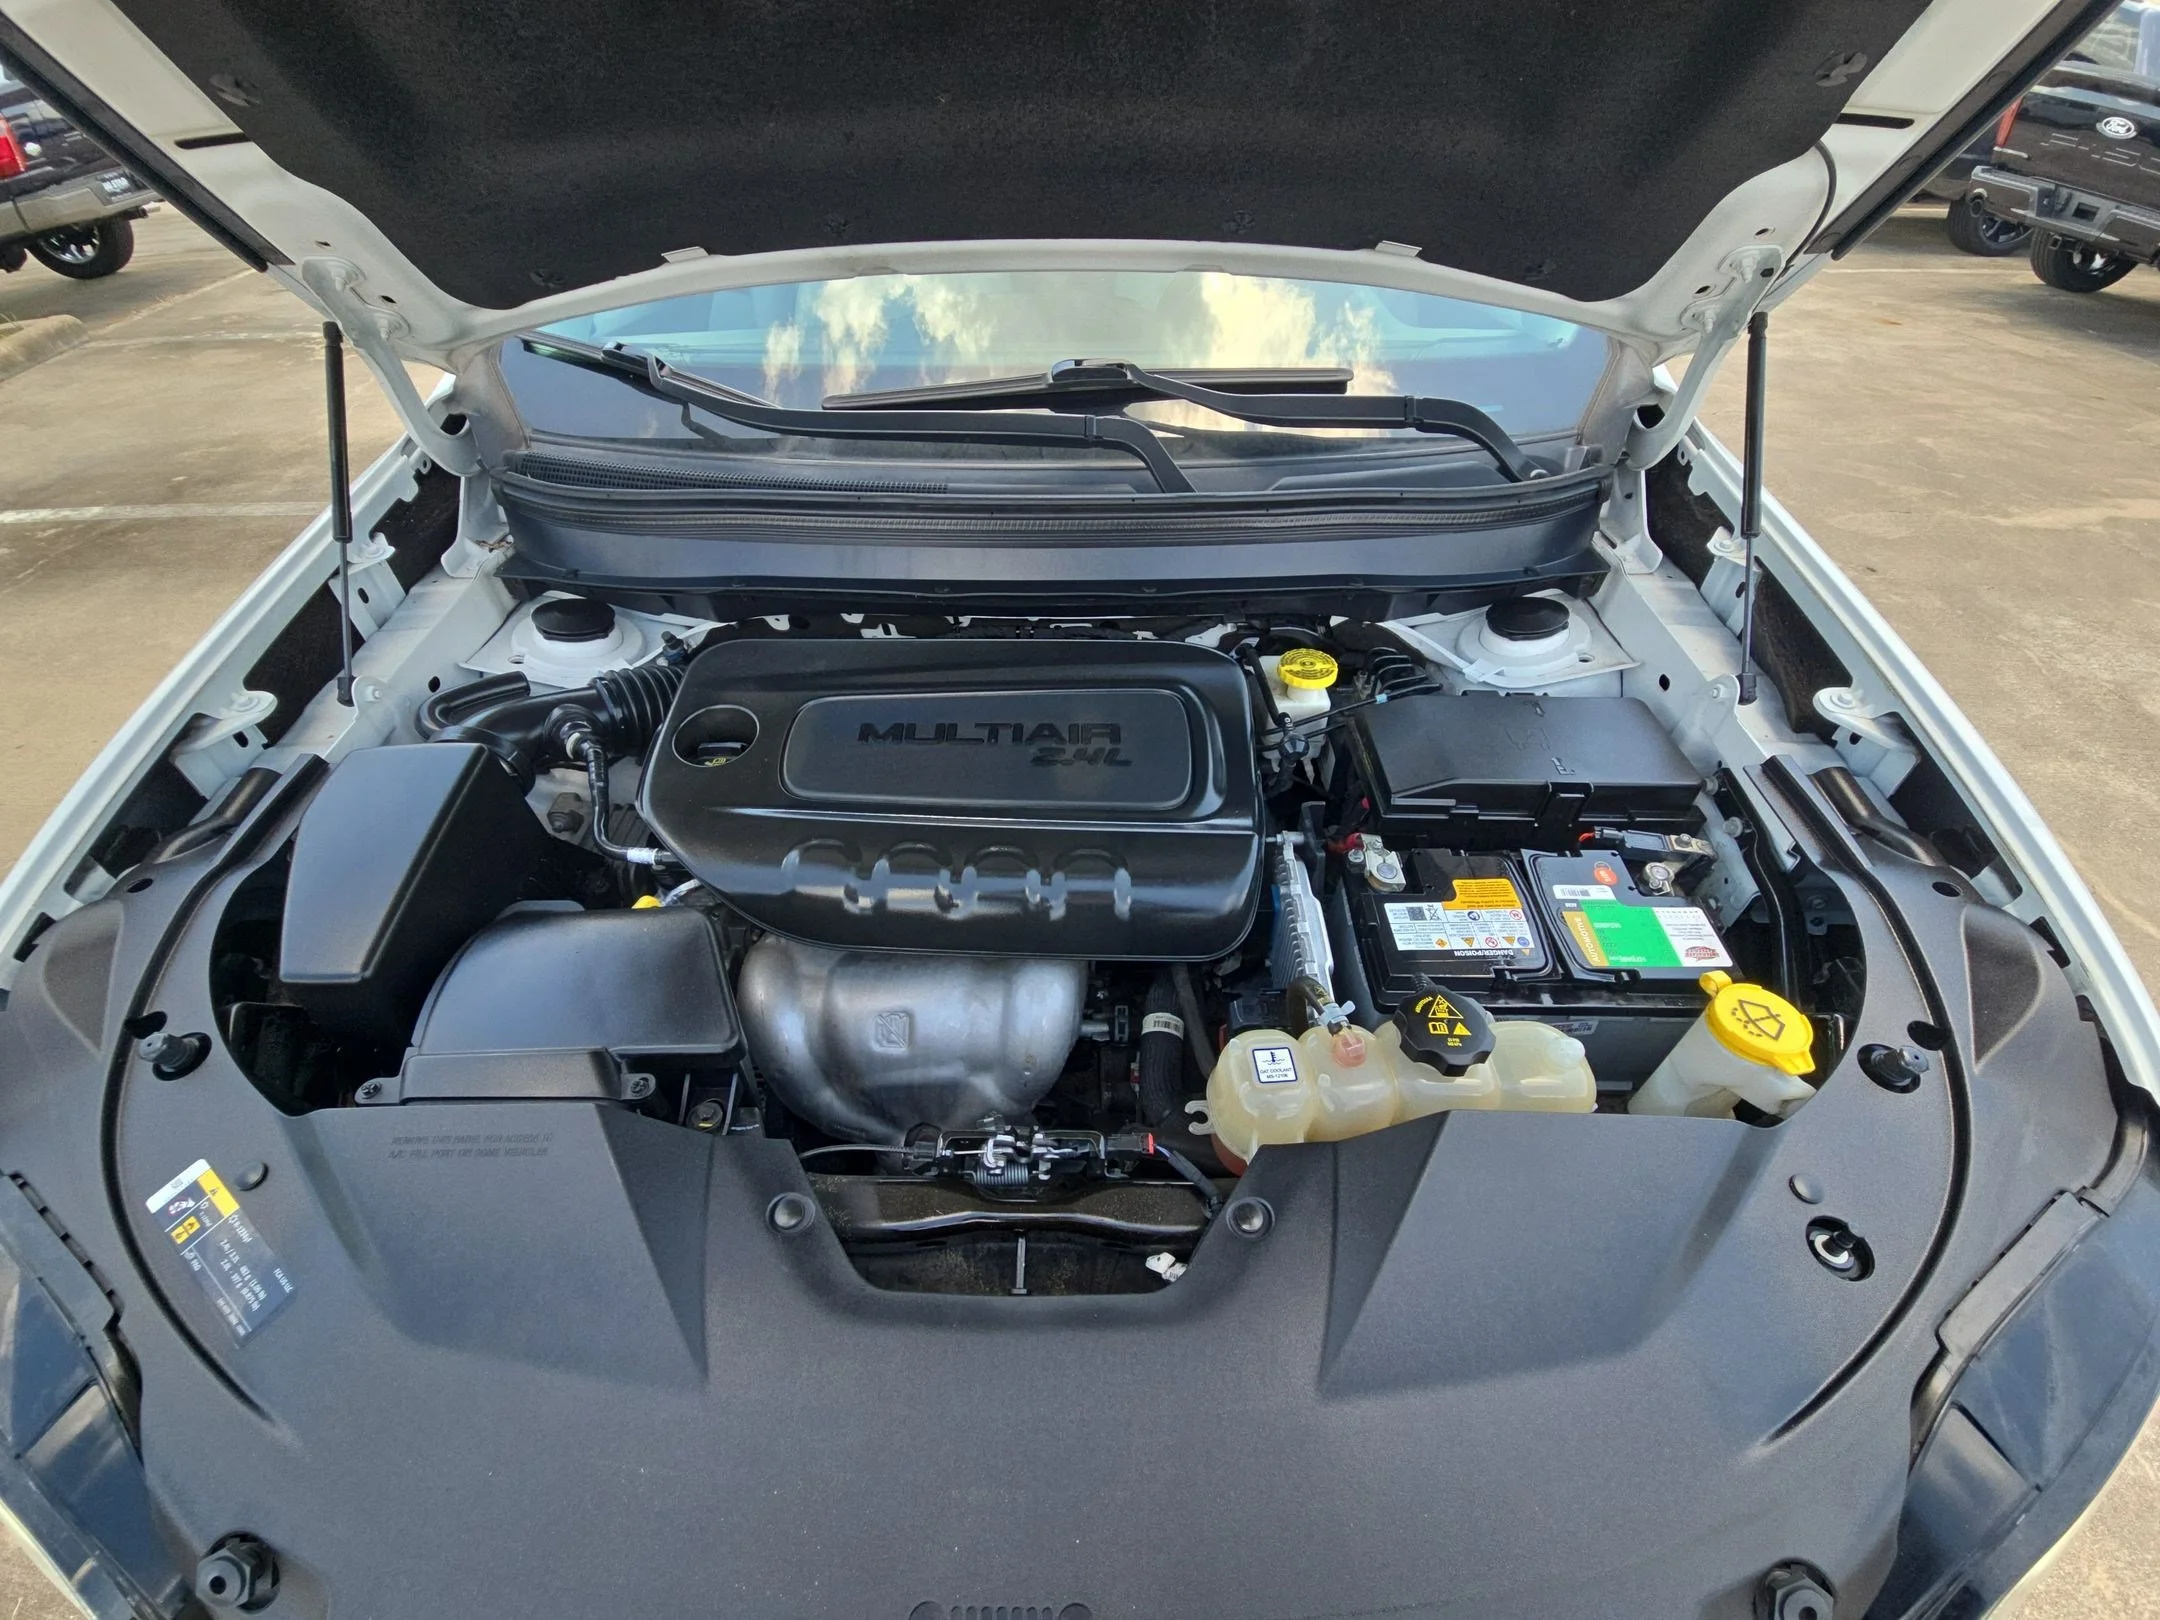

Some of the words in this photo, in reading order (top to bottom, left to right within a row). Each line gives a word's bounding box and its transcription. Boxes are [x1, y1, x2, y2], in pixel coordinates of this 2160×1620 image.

[858, 722, 1122, 746] MULTIAIR
[1029, 746, 1133, 768] 2.4L
[1574, 917, 1600, 963] AUTOMOTIVE
[1454, 949, 1514, 957] DANGER/POISON
